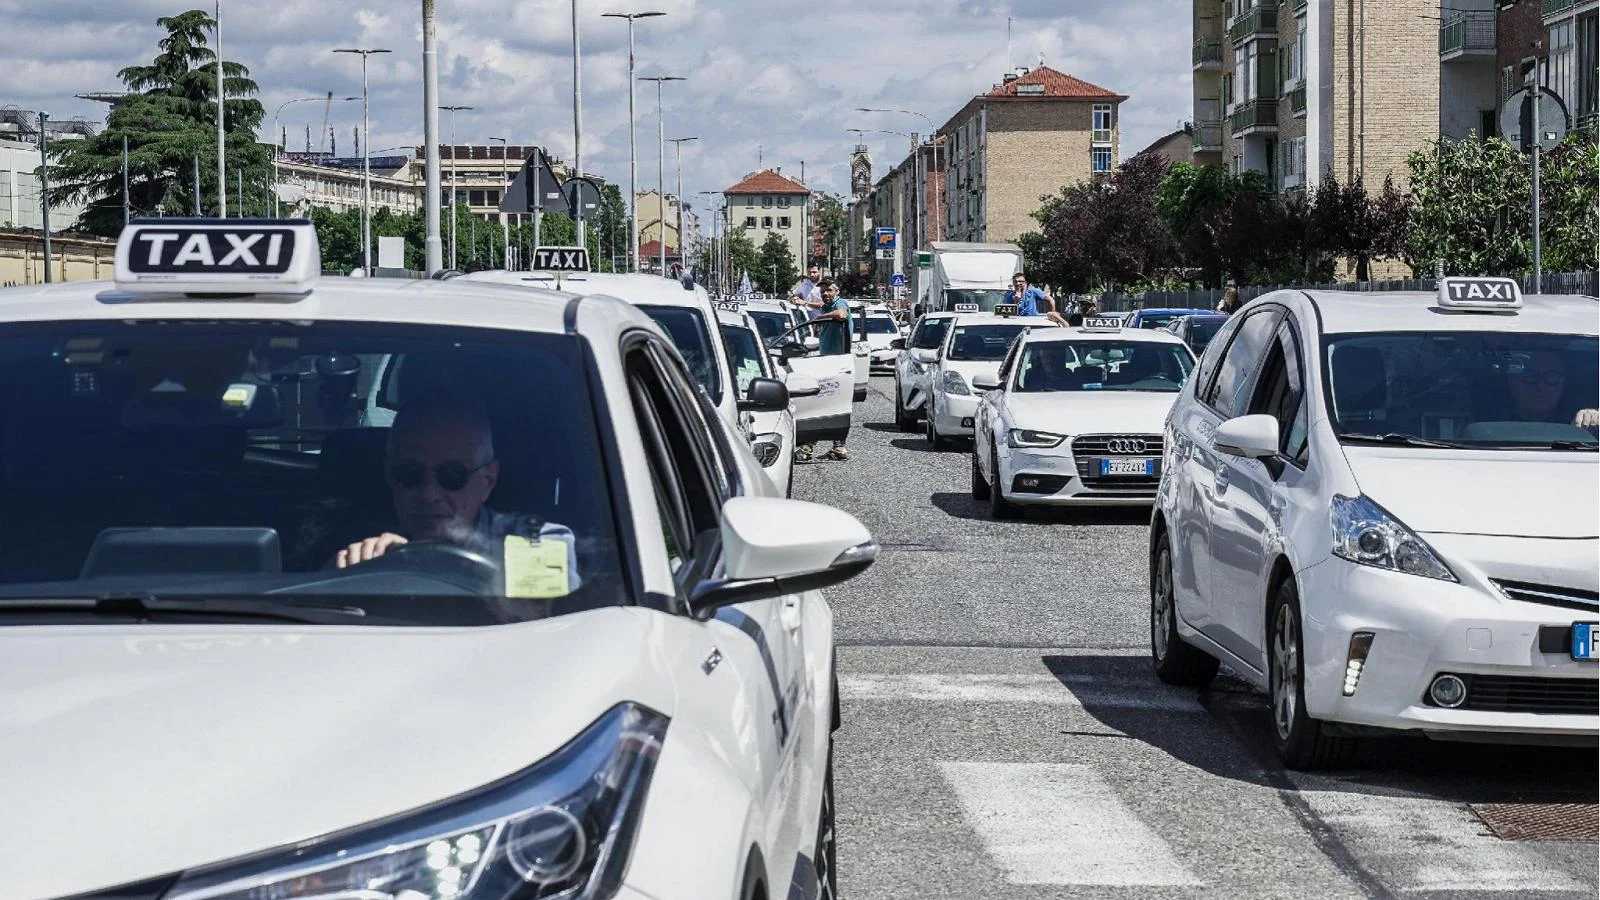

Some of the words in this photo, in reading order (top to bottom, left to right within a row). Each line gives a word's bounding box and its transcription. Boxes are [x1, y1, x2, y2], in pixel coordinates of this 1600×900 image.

[140, 233, 283, 266] TAXI
[537, 251, 584, 269] TAXI
[1449, 283, 1512, 299] TAXI
[714, 303, 737, 311] TAXI
[1087, 319, 1118, 327] TAXI
